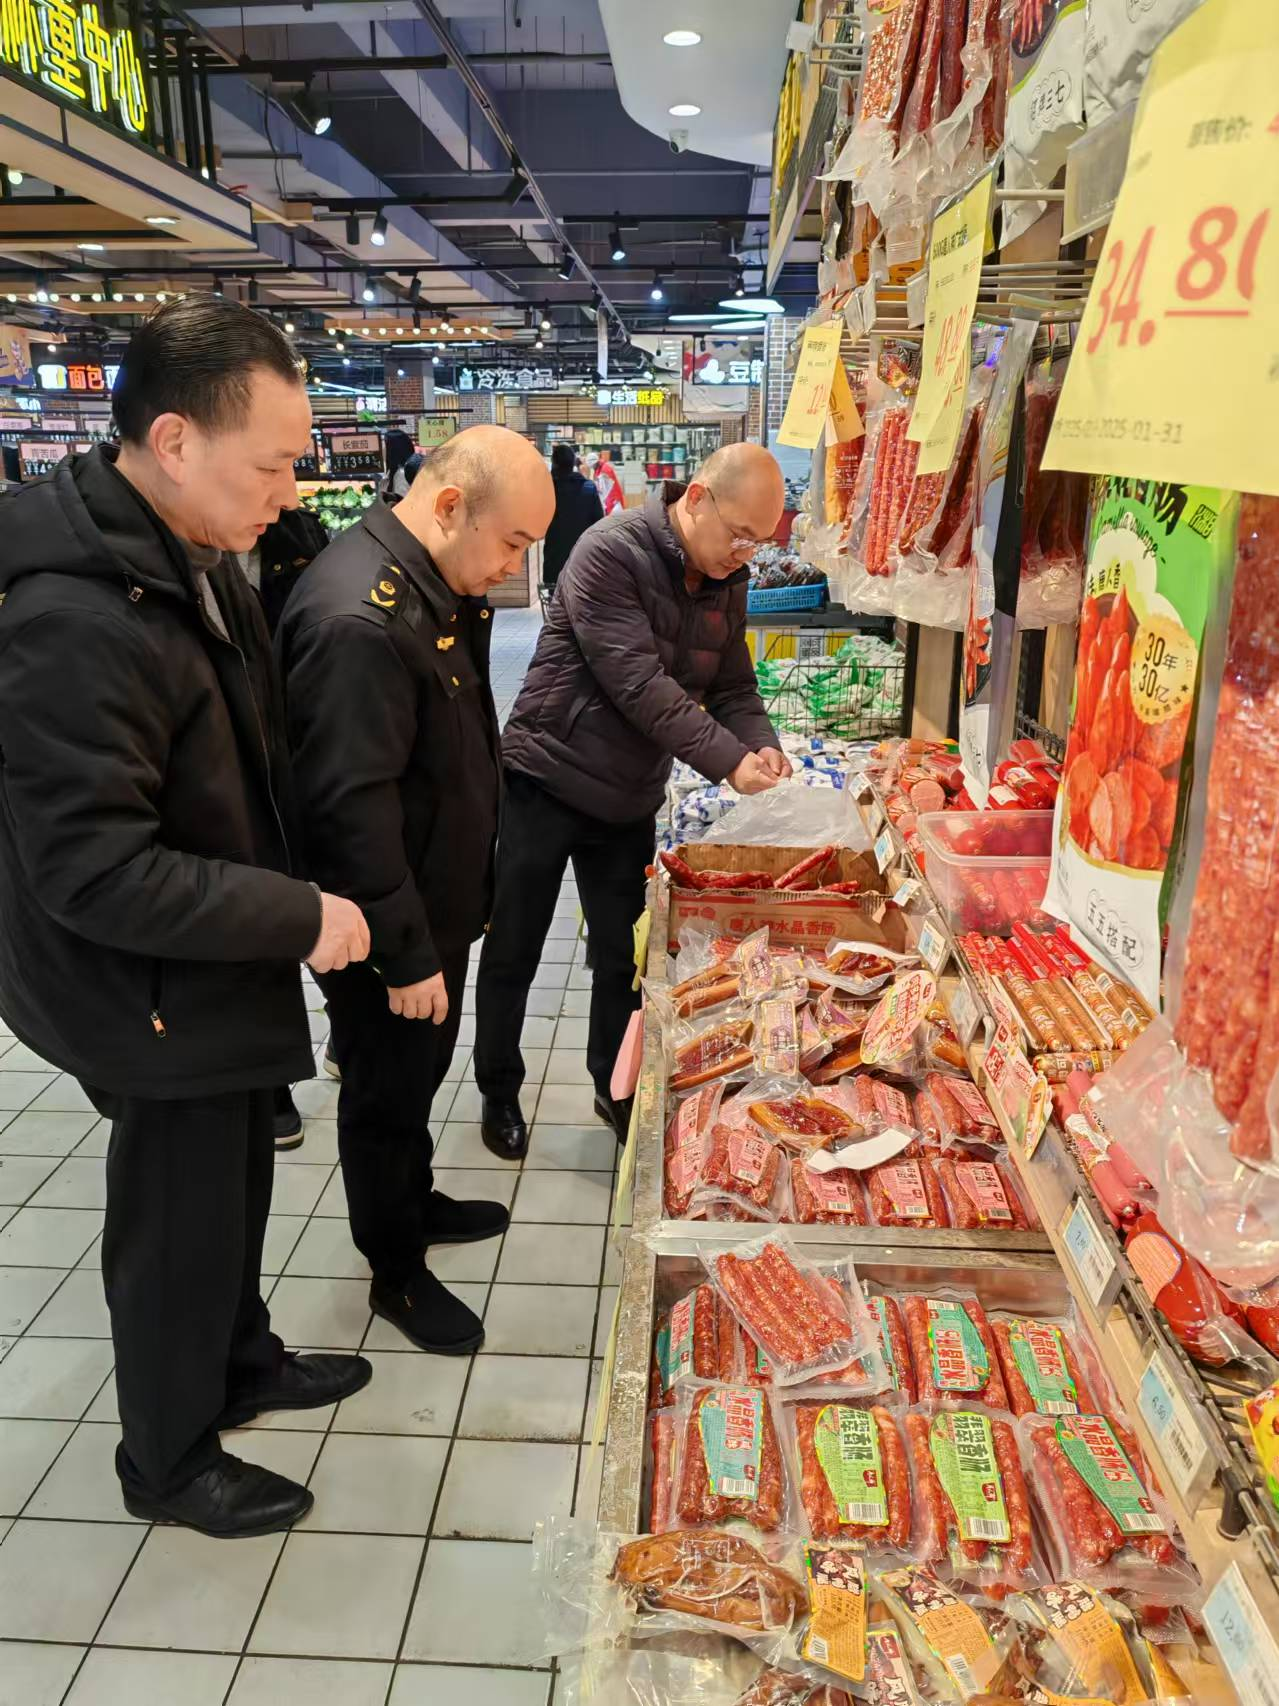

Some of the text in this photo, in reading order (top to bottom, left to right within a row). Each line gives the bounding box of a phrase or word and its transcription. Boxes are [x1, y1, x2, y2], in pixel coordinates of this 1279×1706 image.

[839, 1408, 874, 1461] 翡翠香肠
[953, 1415, 993, 1473] 翡翠香肠
